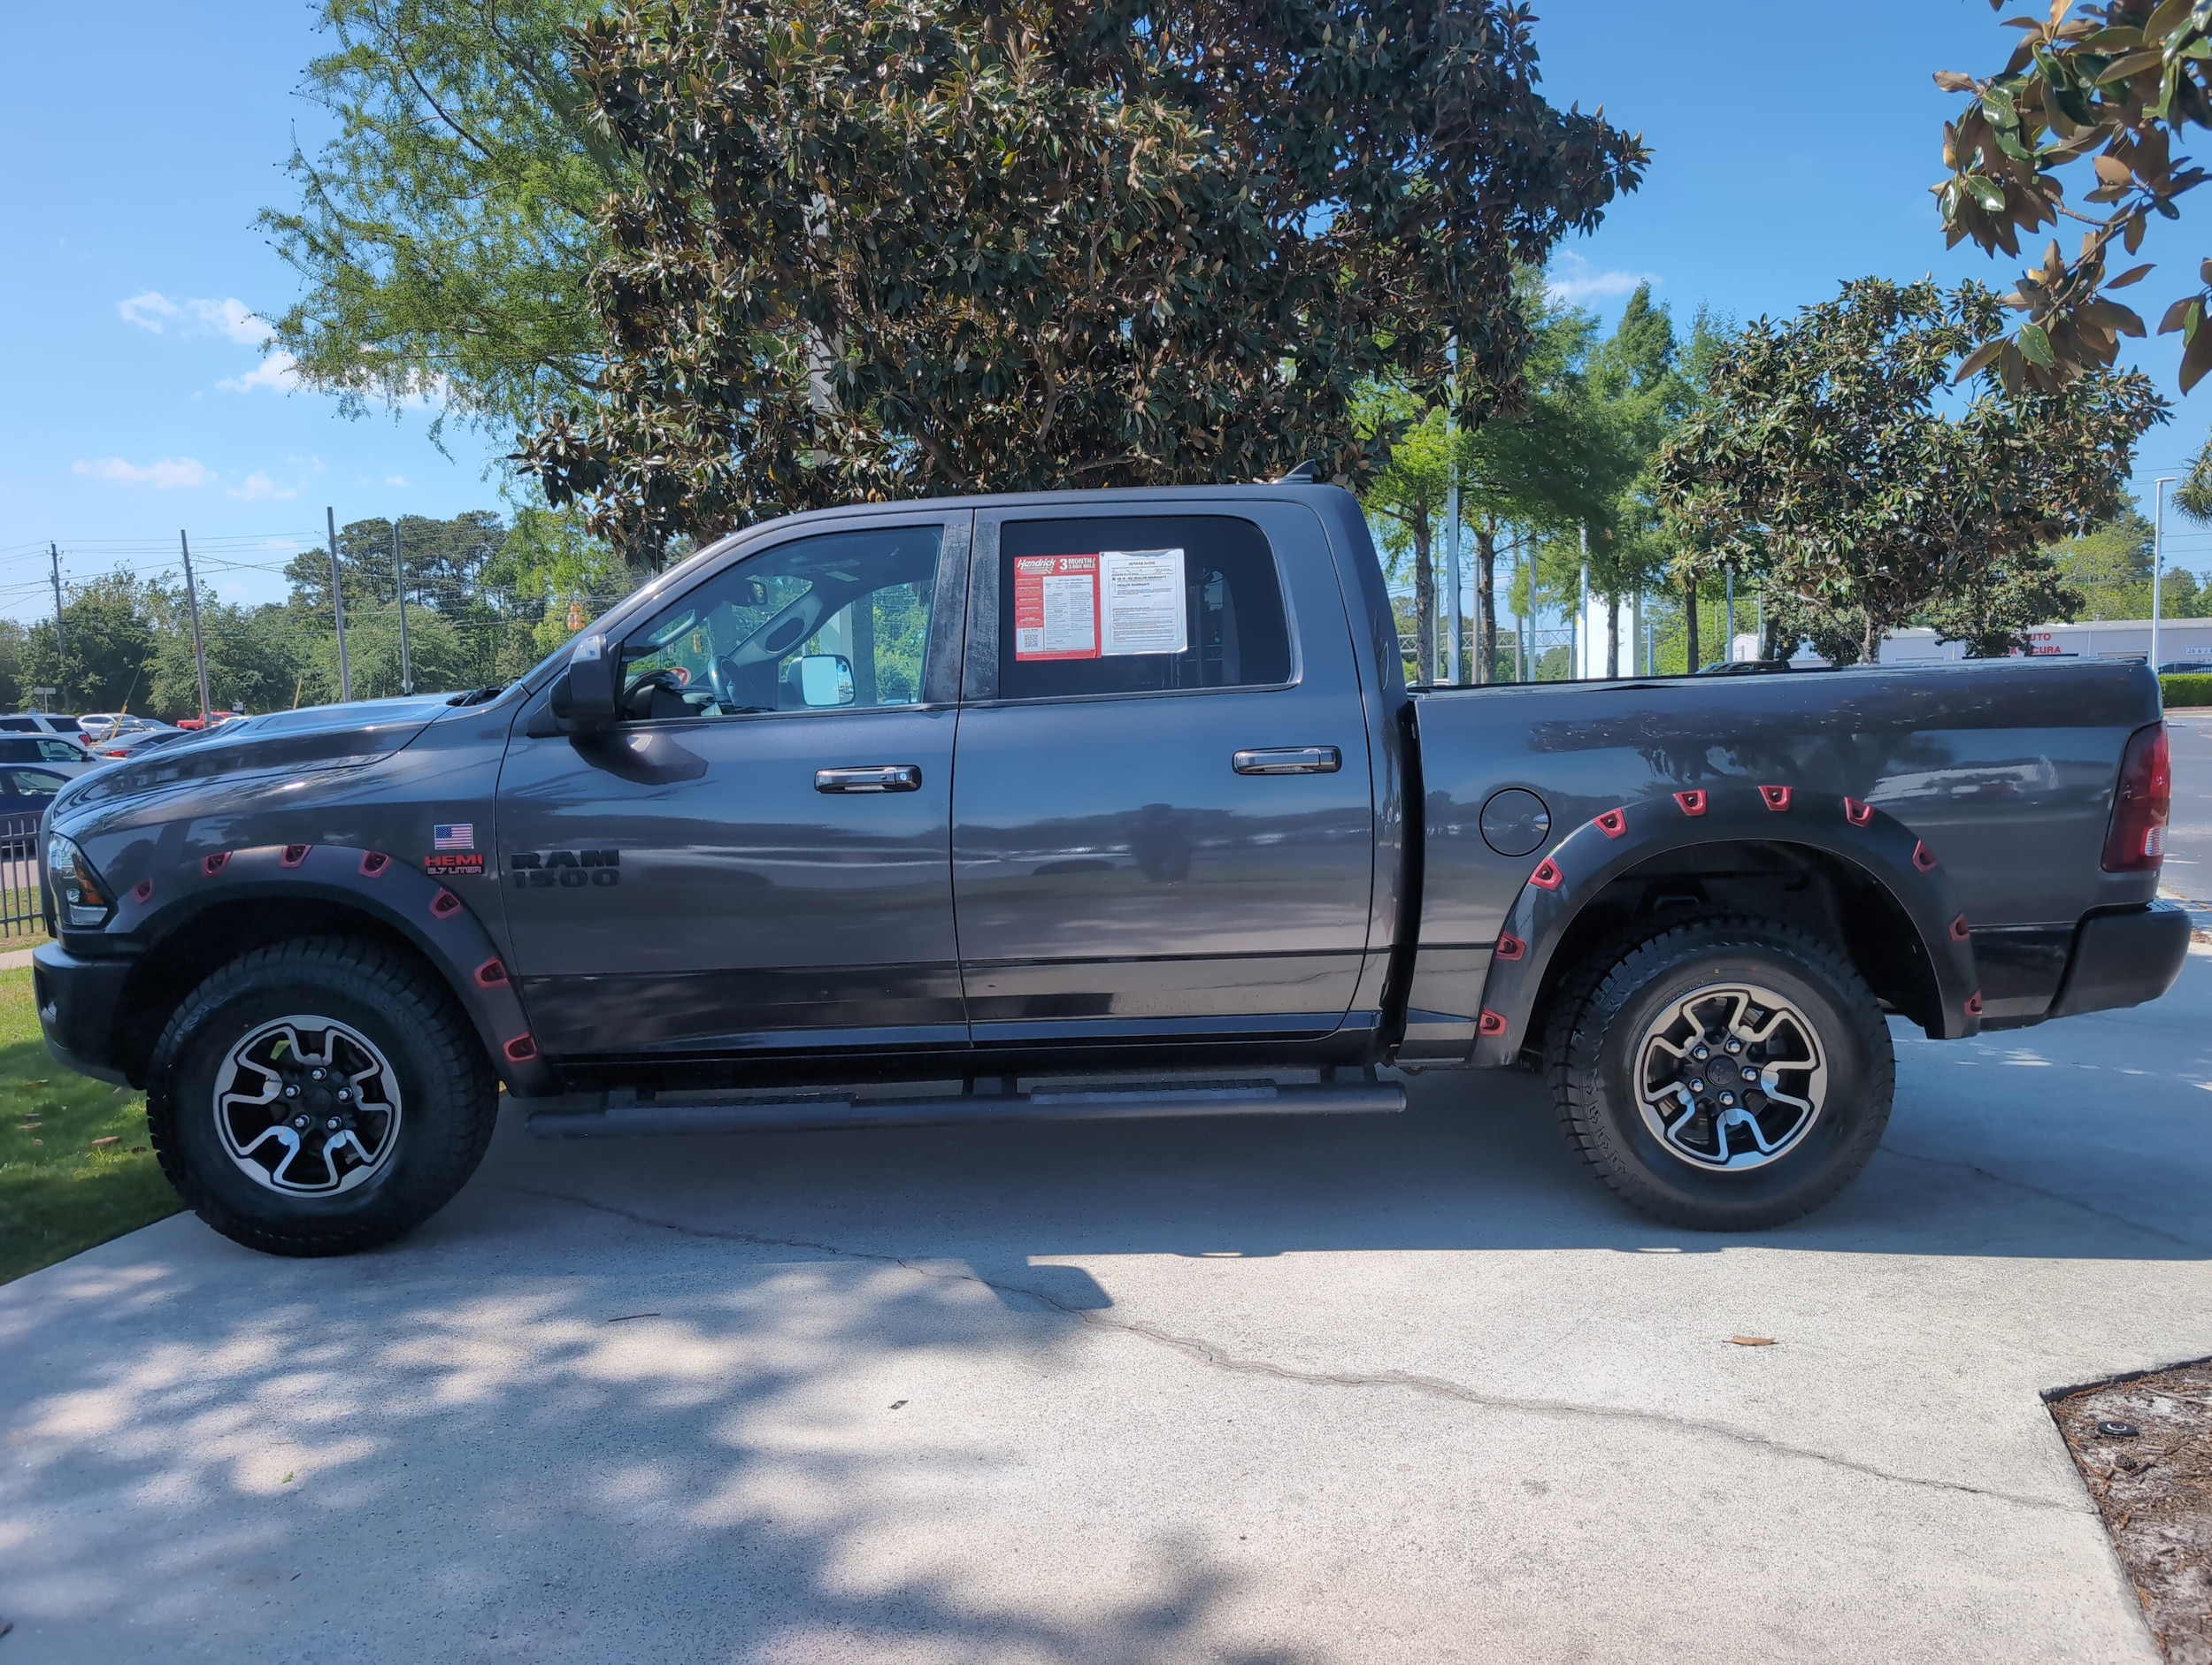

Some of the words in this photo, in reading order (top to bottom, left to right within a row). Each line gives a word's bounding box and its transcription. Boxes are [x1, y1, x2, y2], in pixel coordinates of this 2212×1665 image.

[1059, 557, 1068, 571] 3
[2027, 633, 2052, 641] UTO
[424, 854, 483, 866] HEMI
[511, 848, 620, 870] RAM
[427, 866, 447, 875] 5.7
[448, 865, 482, 874] LITER
[511, 868, 620, 889] 1500
